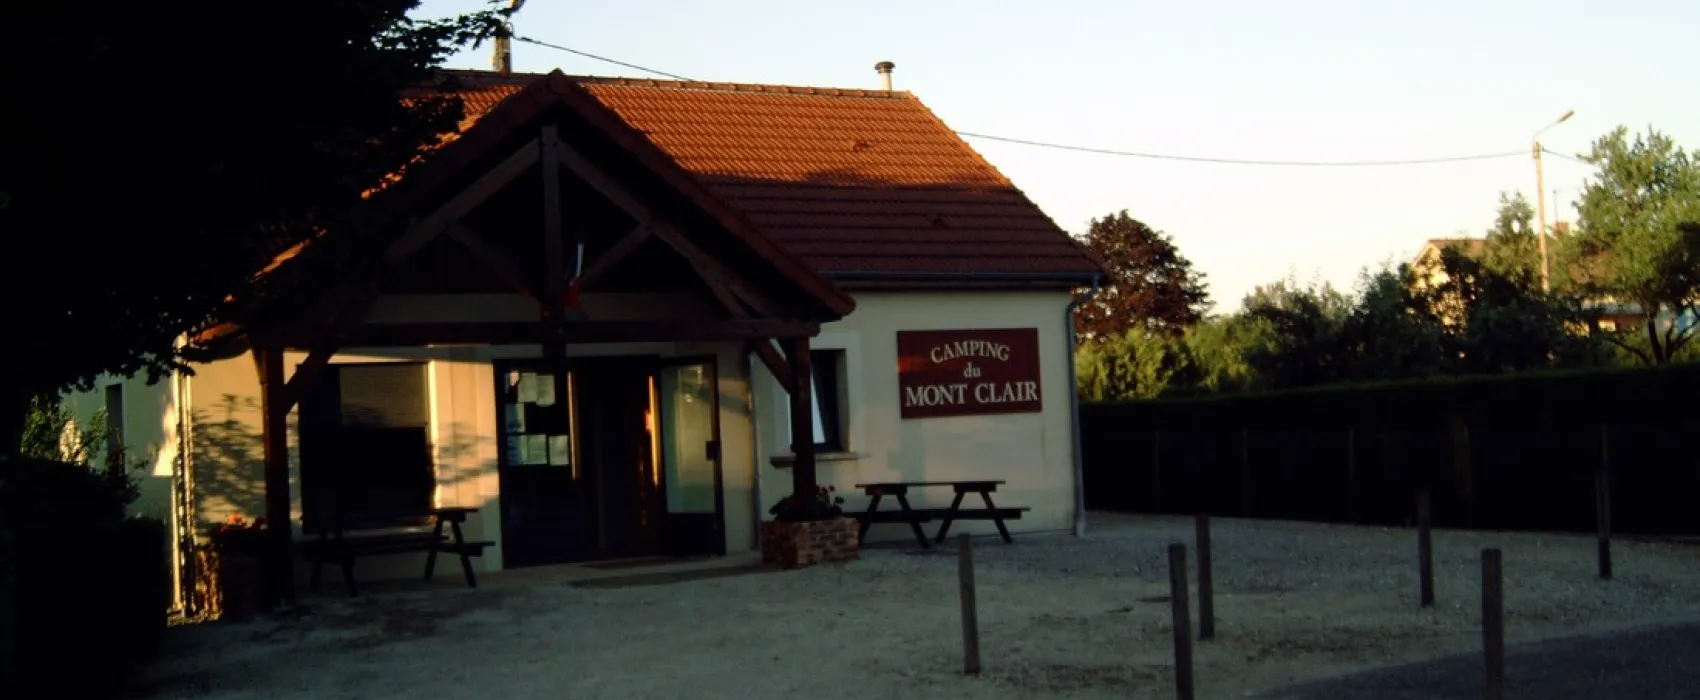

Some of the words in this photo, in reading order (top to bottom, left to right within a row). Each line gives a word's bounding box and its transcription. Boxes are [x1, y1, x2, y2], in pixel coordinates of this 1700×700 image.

[930, 340, 1010, 363] CAMPING
[963, 362, 981, 378] du
[905, 383, 968, 407] MONT
[974, 381, 1038, 403] CLAIR
